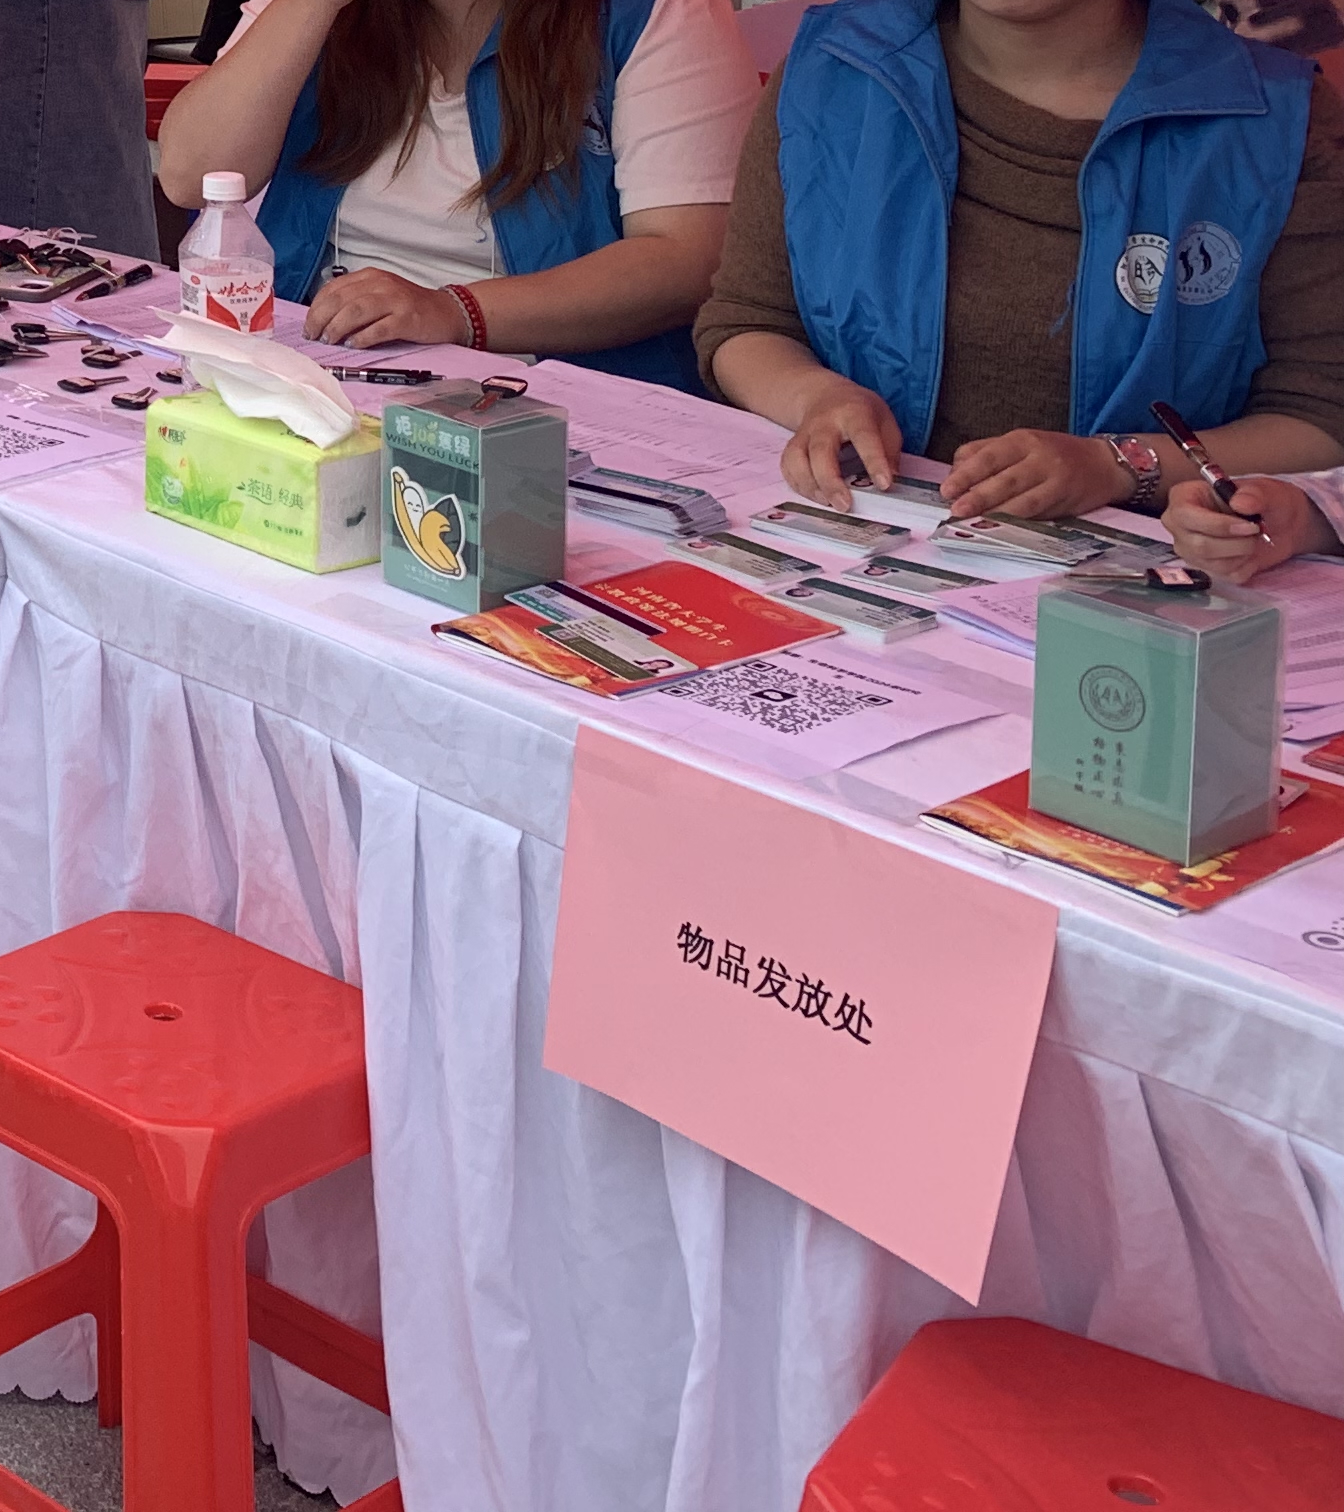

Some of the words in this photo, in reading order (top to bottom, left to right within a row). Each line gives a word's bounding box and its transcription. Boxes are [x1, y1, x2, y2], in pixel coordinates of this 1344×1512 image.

[385, 432, 417, 450] WISH
[420, 444, 446, 459] YOU
[449, 455, 480, 470] LUCK
[676, 920, 875, 1046] 物品发放处
